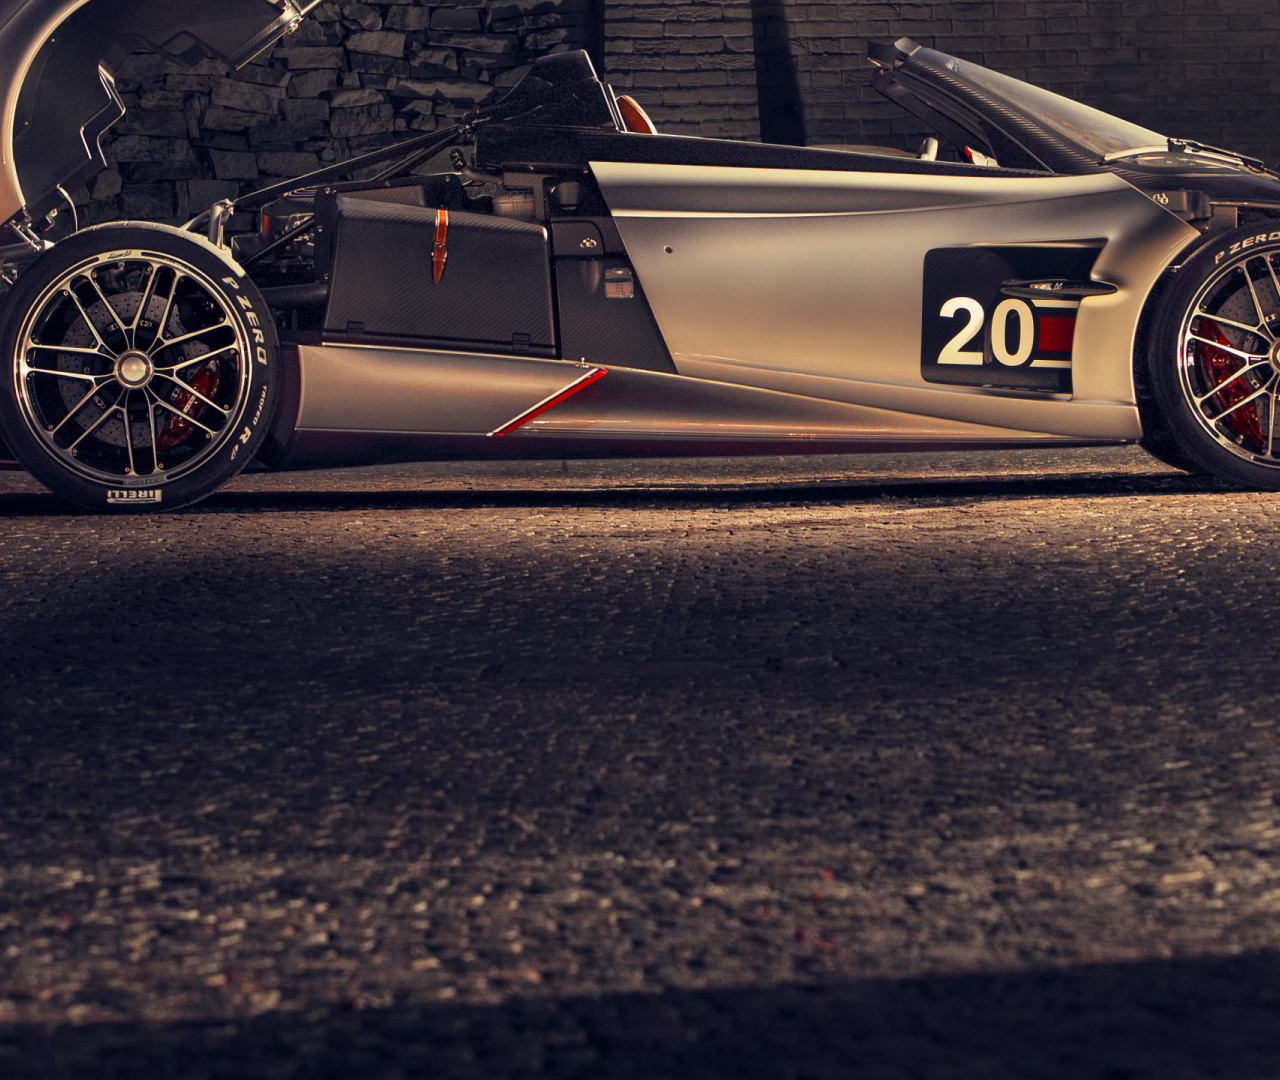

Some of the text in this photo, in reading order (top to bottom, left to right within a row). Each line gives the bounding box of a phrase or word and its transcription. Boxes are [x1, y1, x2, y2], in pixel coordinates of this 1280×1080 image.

[1214, 250, 1225, 264] P
[937, 296, 1035, 367] 20
[221, 276, 267, 444] P ZERO TROFEO R
[106, 489, 162, 504] PIRELLI
